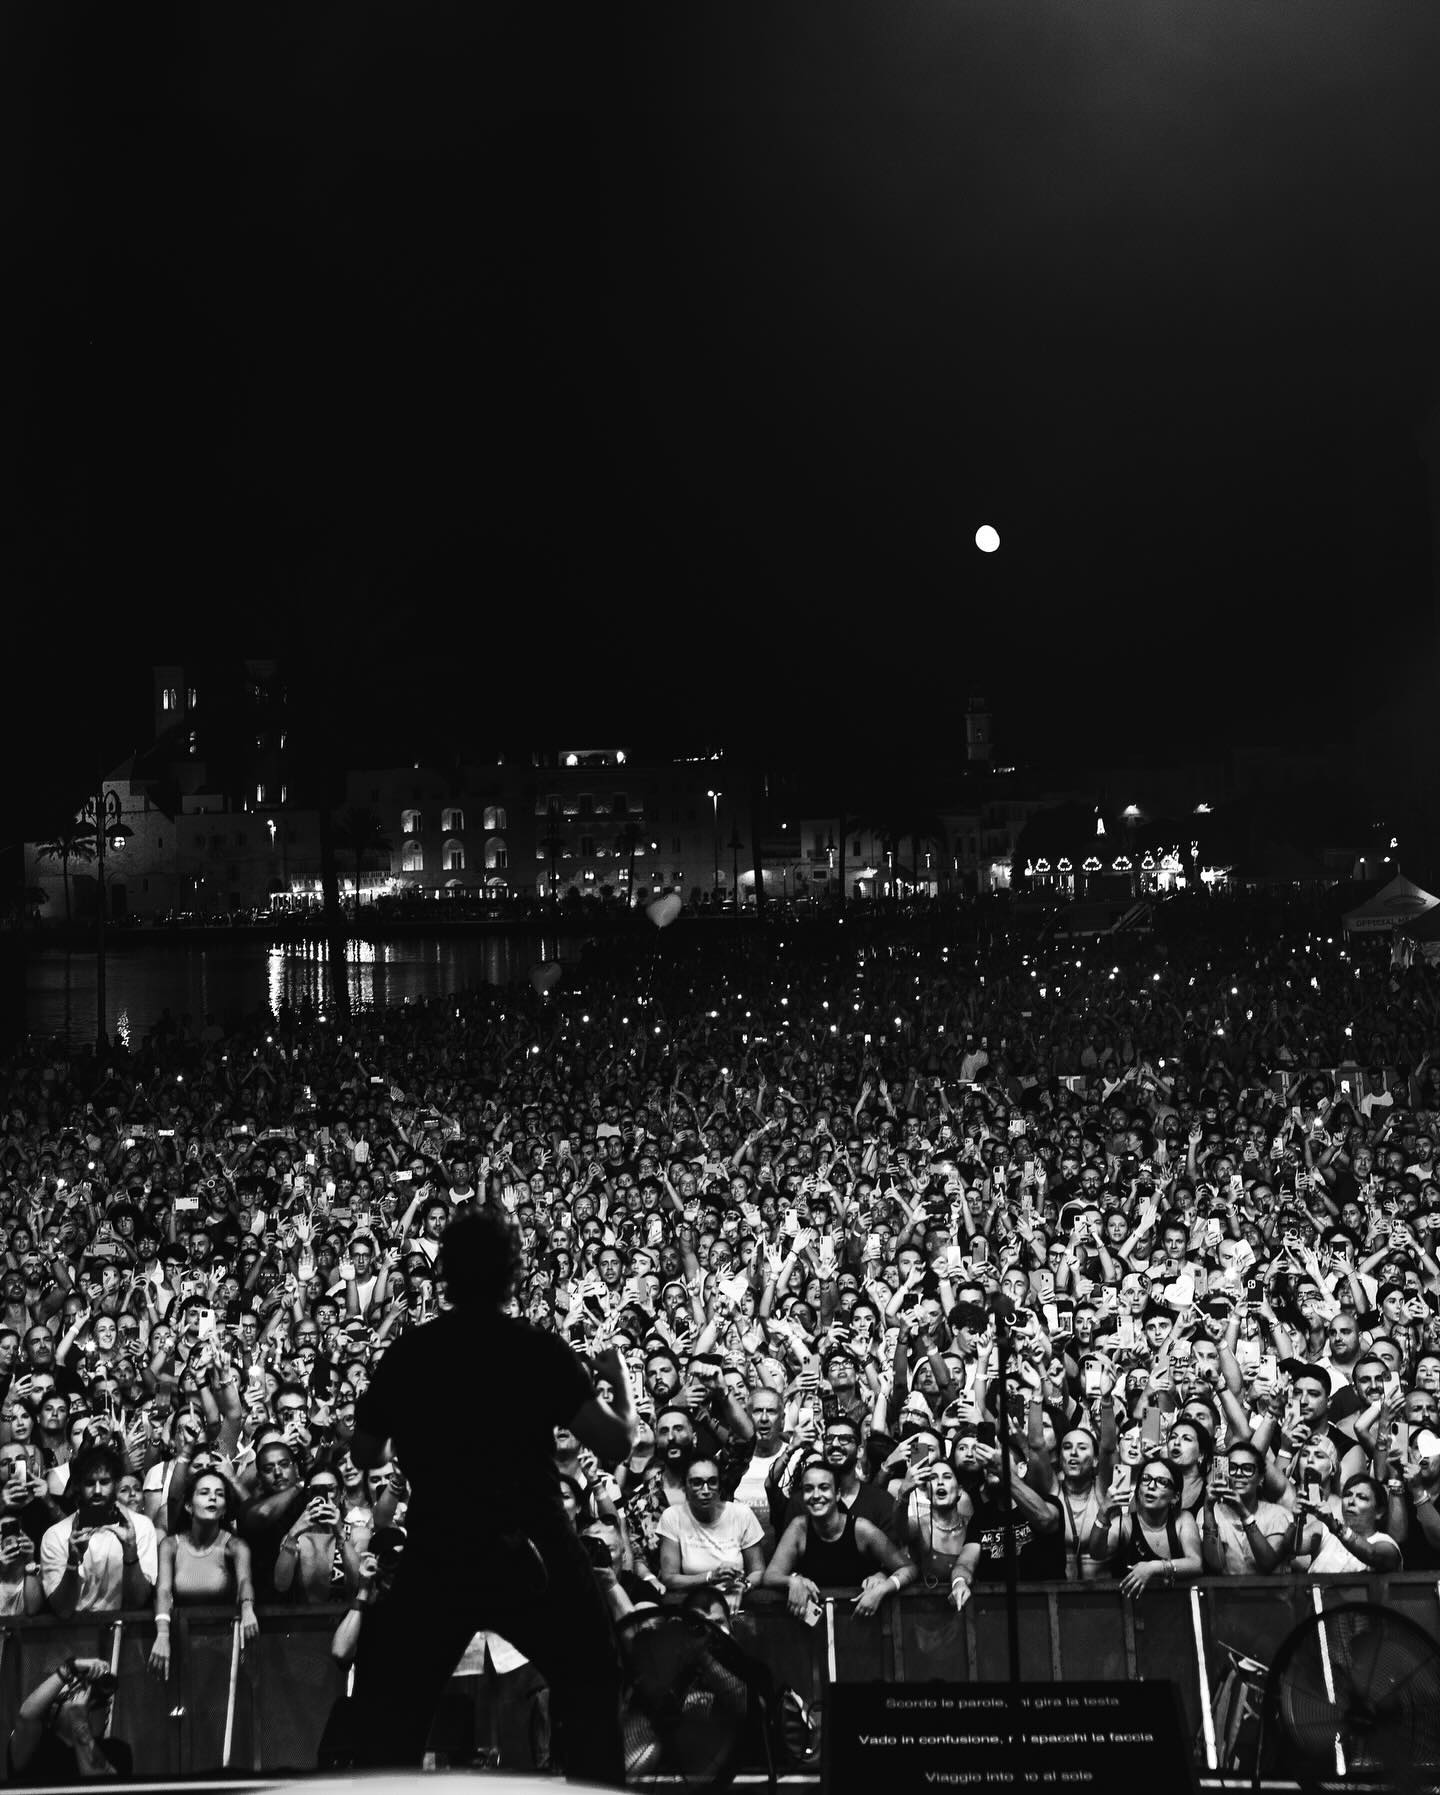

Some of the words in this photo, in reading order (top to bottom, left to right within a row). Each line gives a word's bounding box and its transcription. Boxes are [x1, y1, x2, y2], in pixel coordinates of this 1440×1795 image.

[885, 1697, 937, 1708] Scordo
[941, 1697, 954, 1708] le
[1034, 1696, 1062, 1709] gira
[1066, 1696, 1080, 1707] la
[1083, 1696, 1120, 1706] testa
[858, 1734, 898, 1745] Vado
[901, 1734, 915, 1745] in
[1030, 1732, 1088, 1745] spacchi
[1091, 1732, 1105, 1743] la
[1109, 1731, 1154, 1743] faccia
[924, 1771, 982, 1784] Viaggio
[1043, 1770, 1057, 1782] al
[1060, 1769, 1094, 1782] sole
